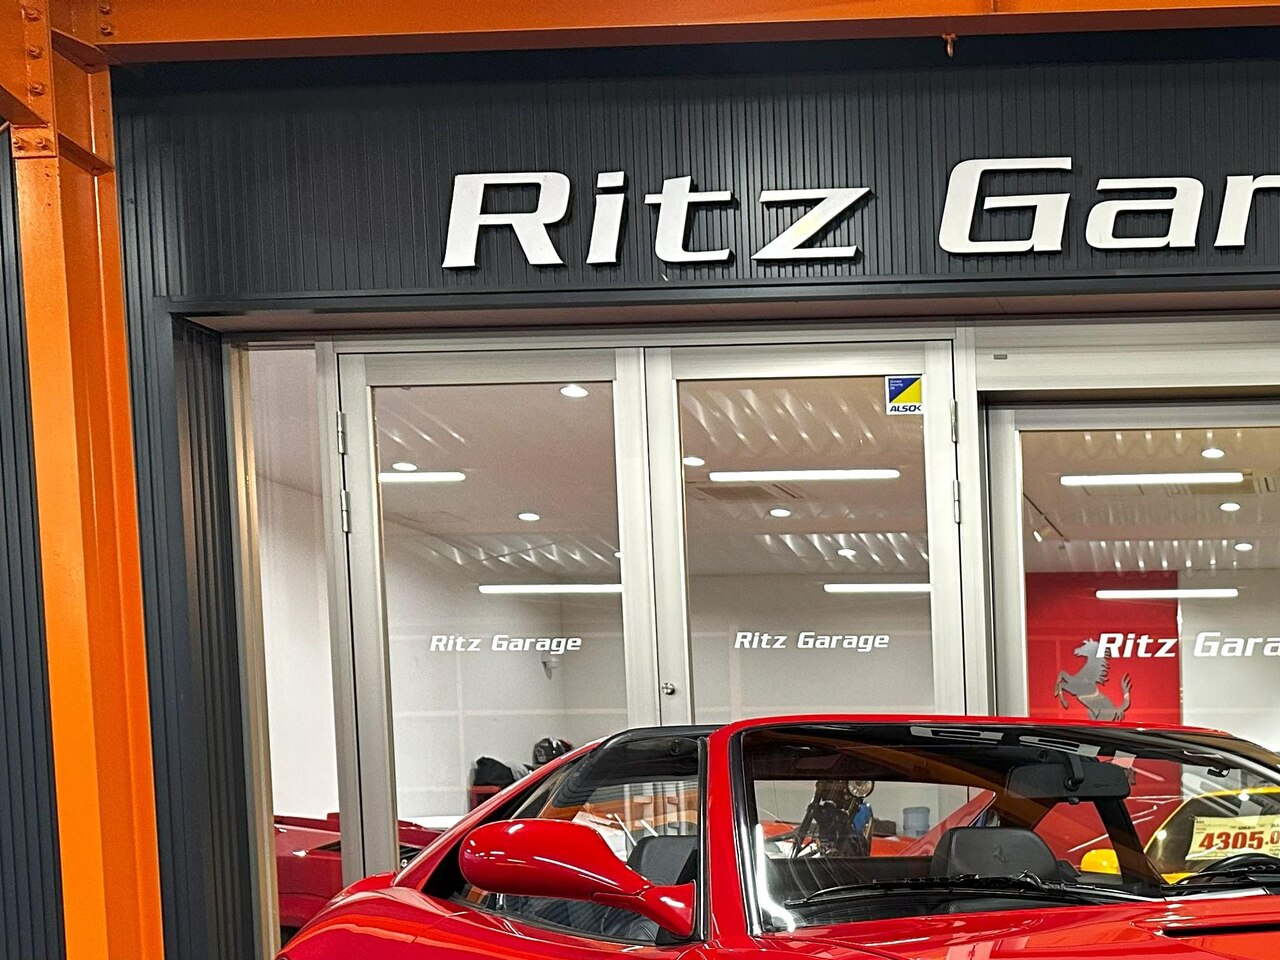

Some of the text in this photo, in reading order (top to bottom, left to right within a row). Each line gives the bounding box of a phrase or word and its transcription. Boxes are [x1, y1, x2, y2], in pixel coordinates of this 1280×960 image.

[442, 170, 871, 268] Ritz
[889, 404, 922, 413] ALSOK
[430, 634, 582, 655] Ritz Garage
[734, 631, 890, 652] Ritz Garage
[1096, 632, 1178, 658] Ritz
